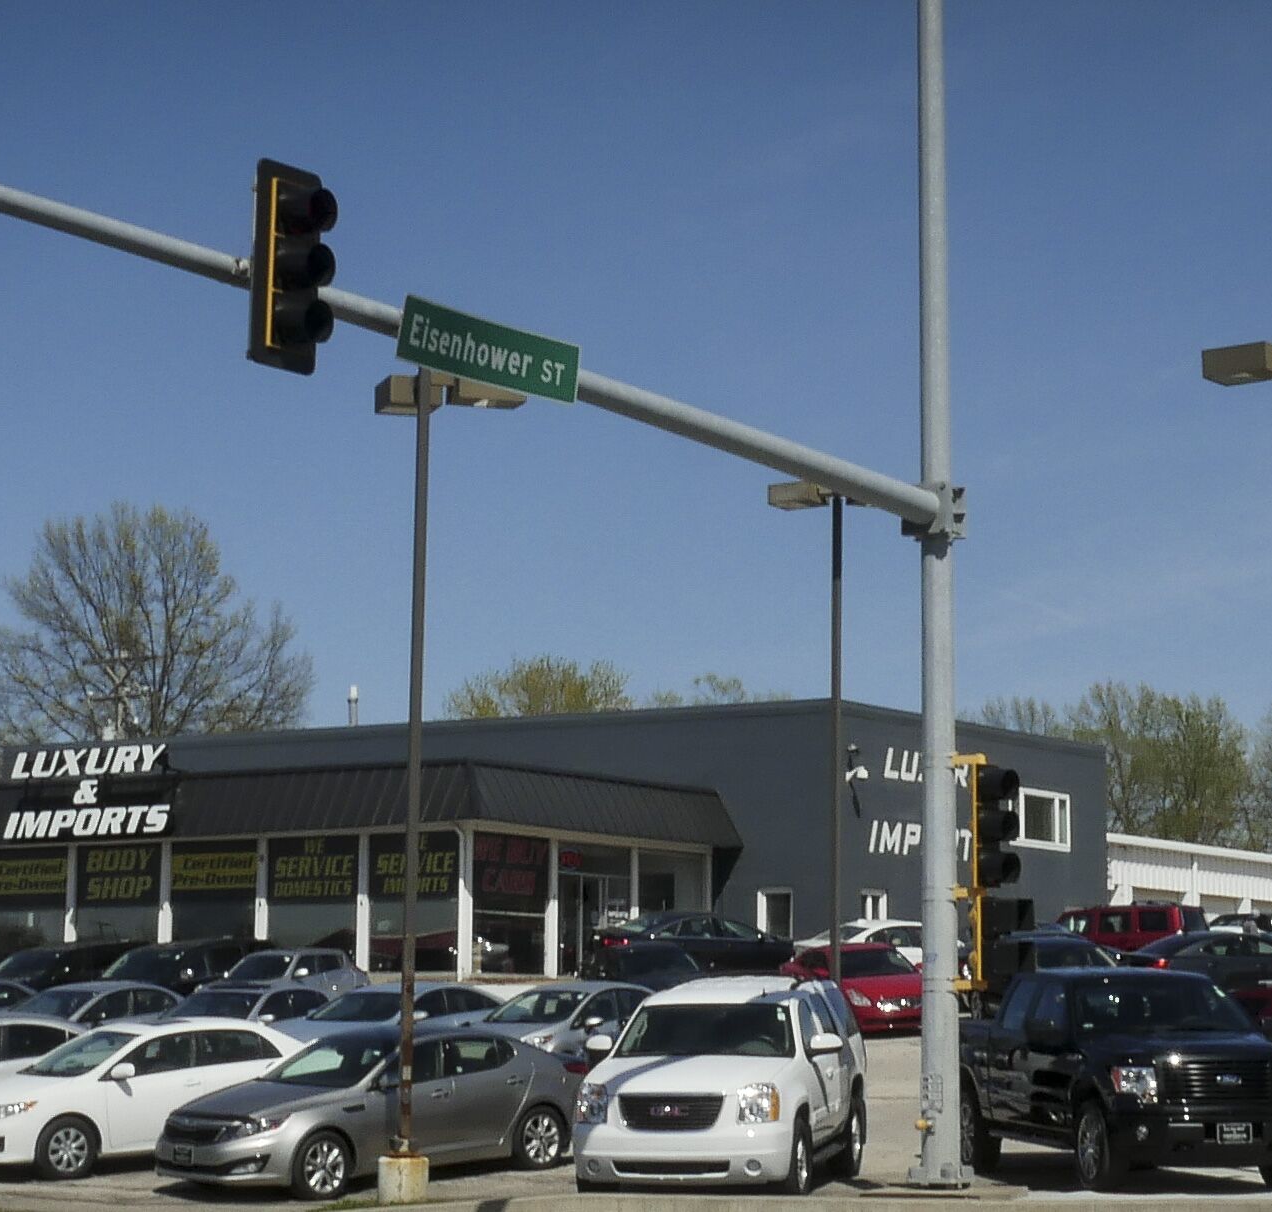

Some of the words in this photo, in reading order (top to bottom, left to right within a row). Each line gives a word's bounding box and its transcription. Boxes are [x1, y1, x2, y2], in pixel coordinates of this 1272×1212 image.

[408, 313, 533, 378] Eisenhower
[540, 359, 566, 387] ST
[11, 743, 167, 780] LUXURY
[72, 778, 99, 804] &
[3, 803, 171, 840] IMPORTS
[86, 849, 153, 873] BODY
[183, 856, 254, 871] Certified
[275, 855, 355, 878] SERVICE
[86, 875, 153, 900] SHOP
[274, 880, 353, 897] DOMESTICS
